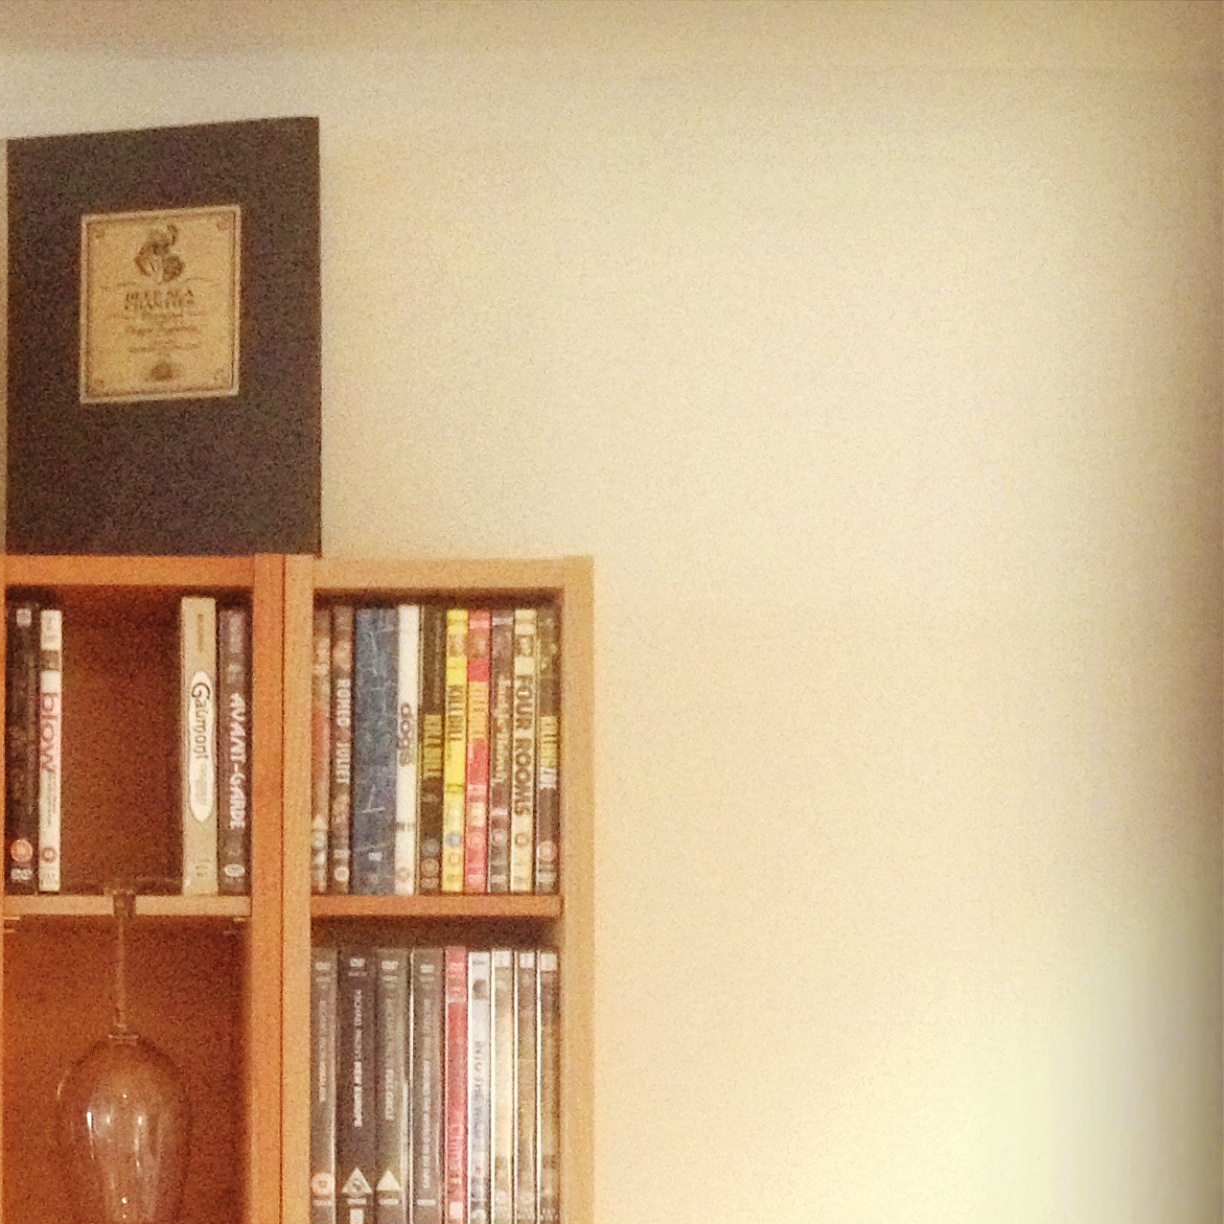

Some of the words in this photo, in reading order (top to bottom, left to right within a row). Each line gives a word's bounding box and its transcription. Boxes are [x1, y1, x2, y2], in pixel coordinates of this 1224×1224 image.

[40, 692, 58, 773] blow
[190, 682, 211, 760] Gaumont
[336, 678, 351, 728] ROMEO
[396, 703, 412, 767] dogs
[514, 674, 533, 730] FOUR
[230, 692, 246, 830] AVANT-GARDE
[336, 741, 351, 786] JULIET
[514, 739, 533, 817] ROOMS
